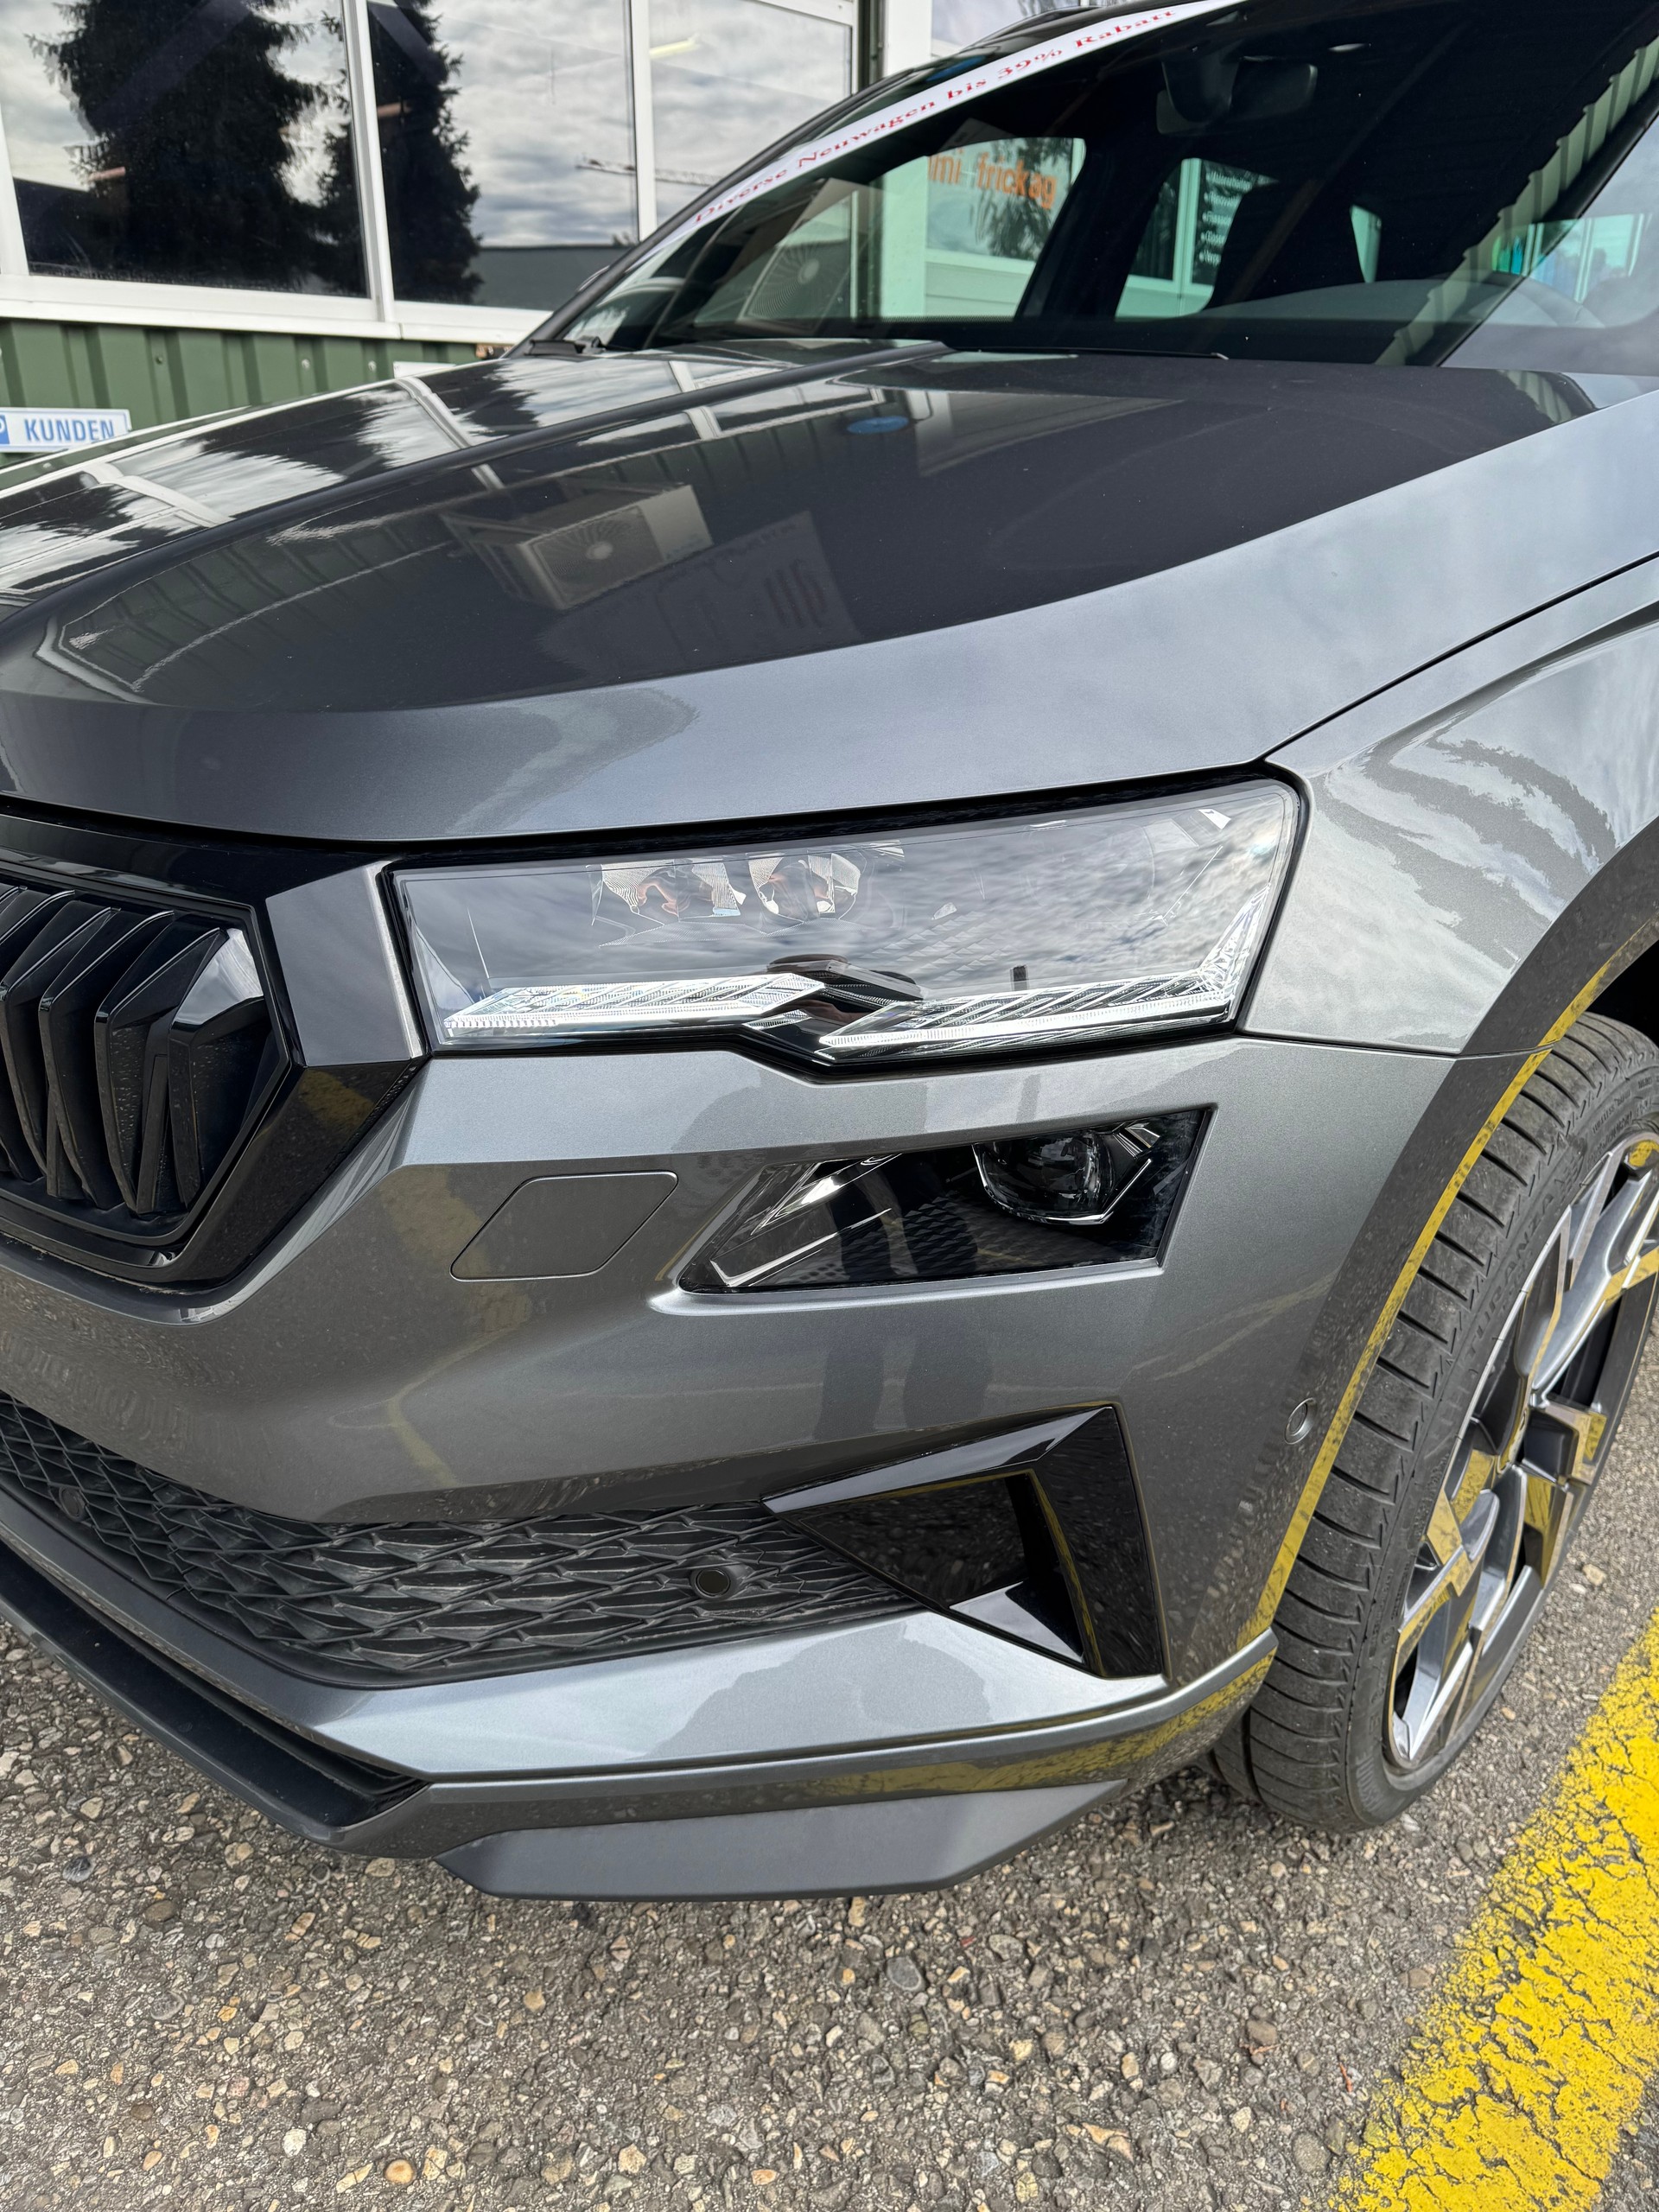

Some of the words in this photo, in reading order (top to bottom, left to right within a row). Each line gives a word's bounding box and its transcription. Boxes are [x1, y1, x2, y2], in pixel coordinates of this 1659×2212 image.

[694, 169, 787, 223] Diverse
[798, 101, 936, 168] Neuwagen
[947, 79, 987, 100] bis
[997, 49, 1063, 79] 39%
[1075, 10, 1175, 48] Rabatt
[24, 418, 115, 441] KUNDEN
[1465, 1194, 1554, 1361] TURANZA
